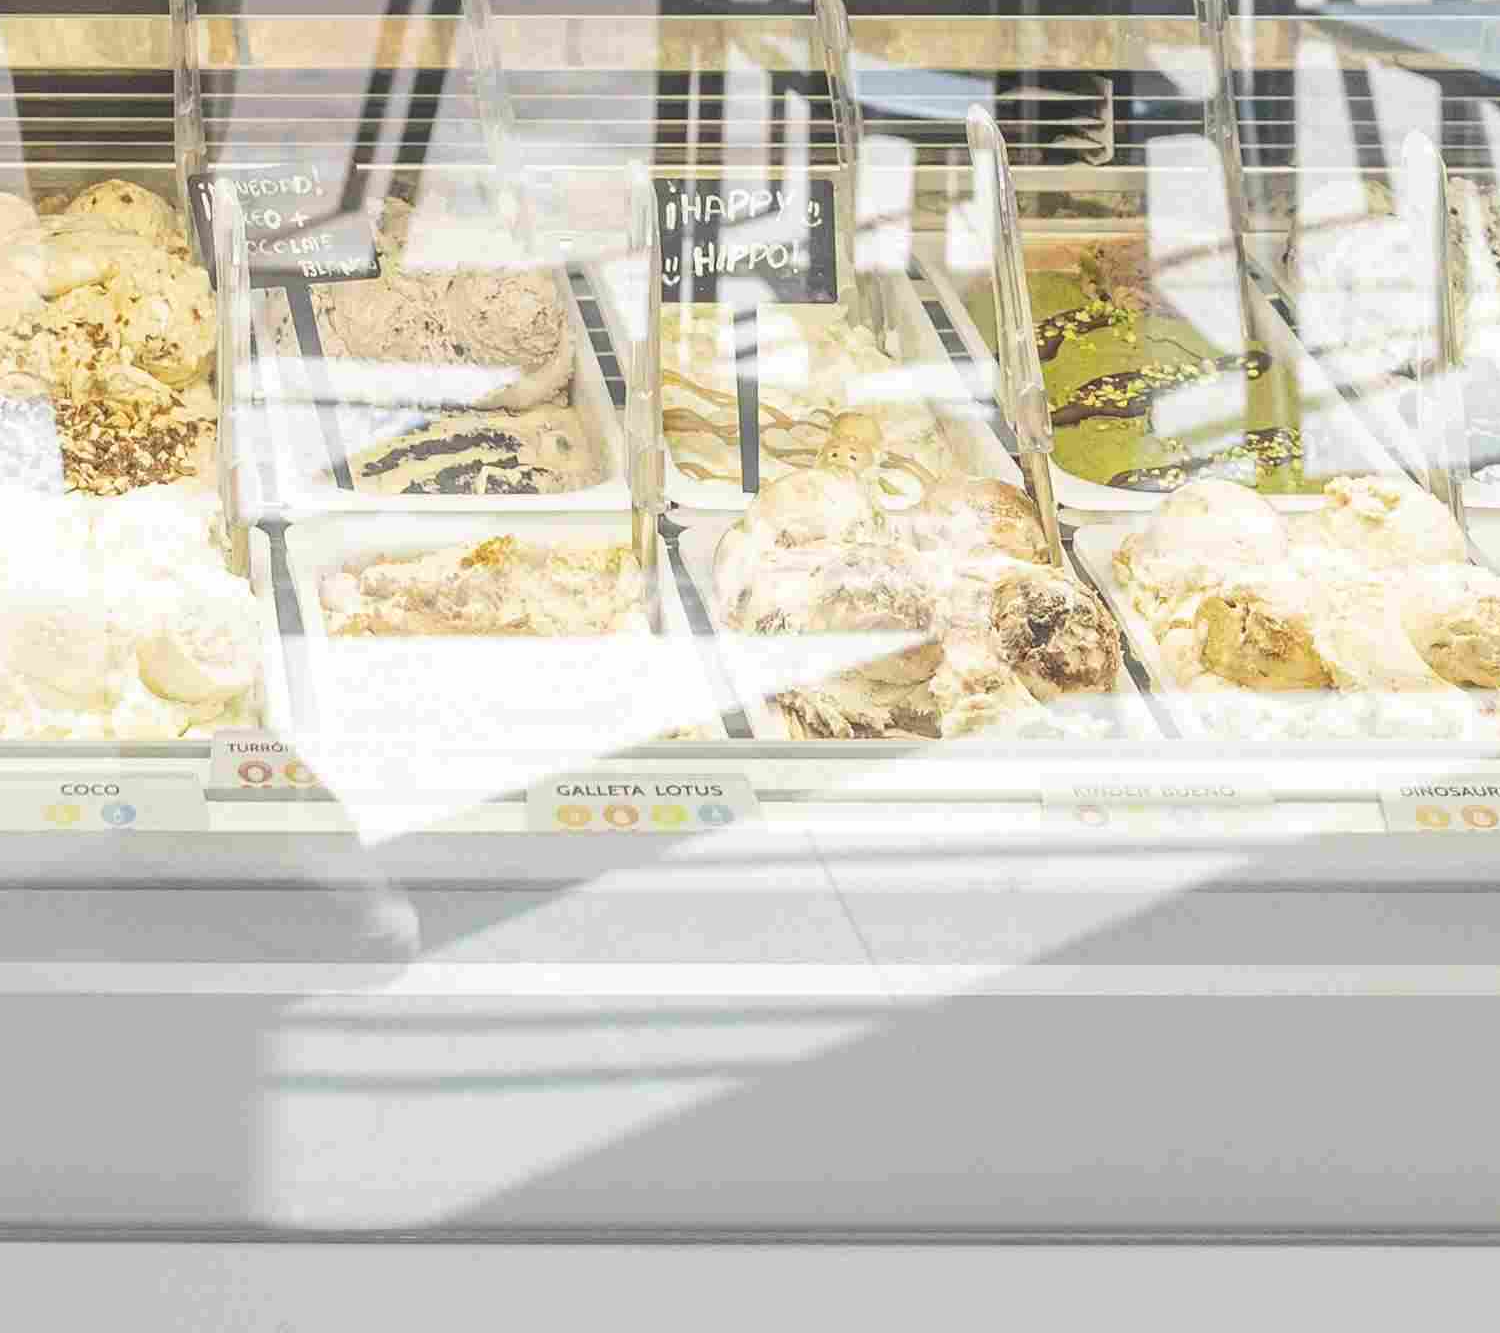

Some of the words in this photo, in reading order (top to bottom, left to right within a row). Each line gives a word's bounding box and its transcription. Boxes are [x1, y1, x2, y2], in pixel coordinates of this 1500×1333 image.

[60, 783, 121, 797] COCO
[556, 784, 647, 797] GALLETA
[655, 784, 724, 797] LOTUS
